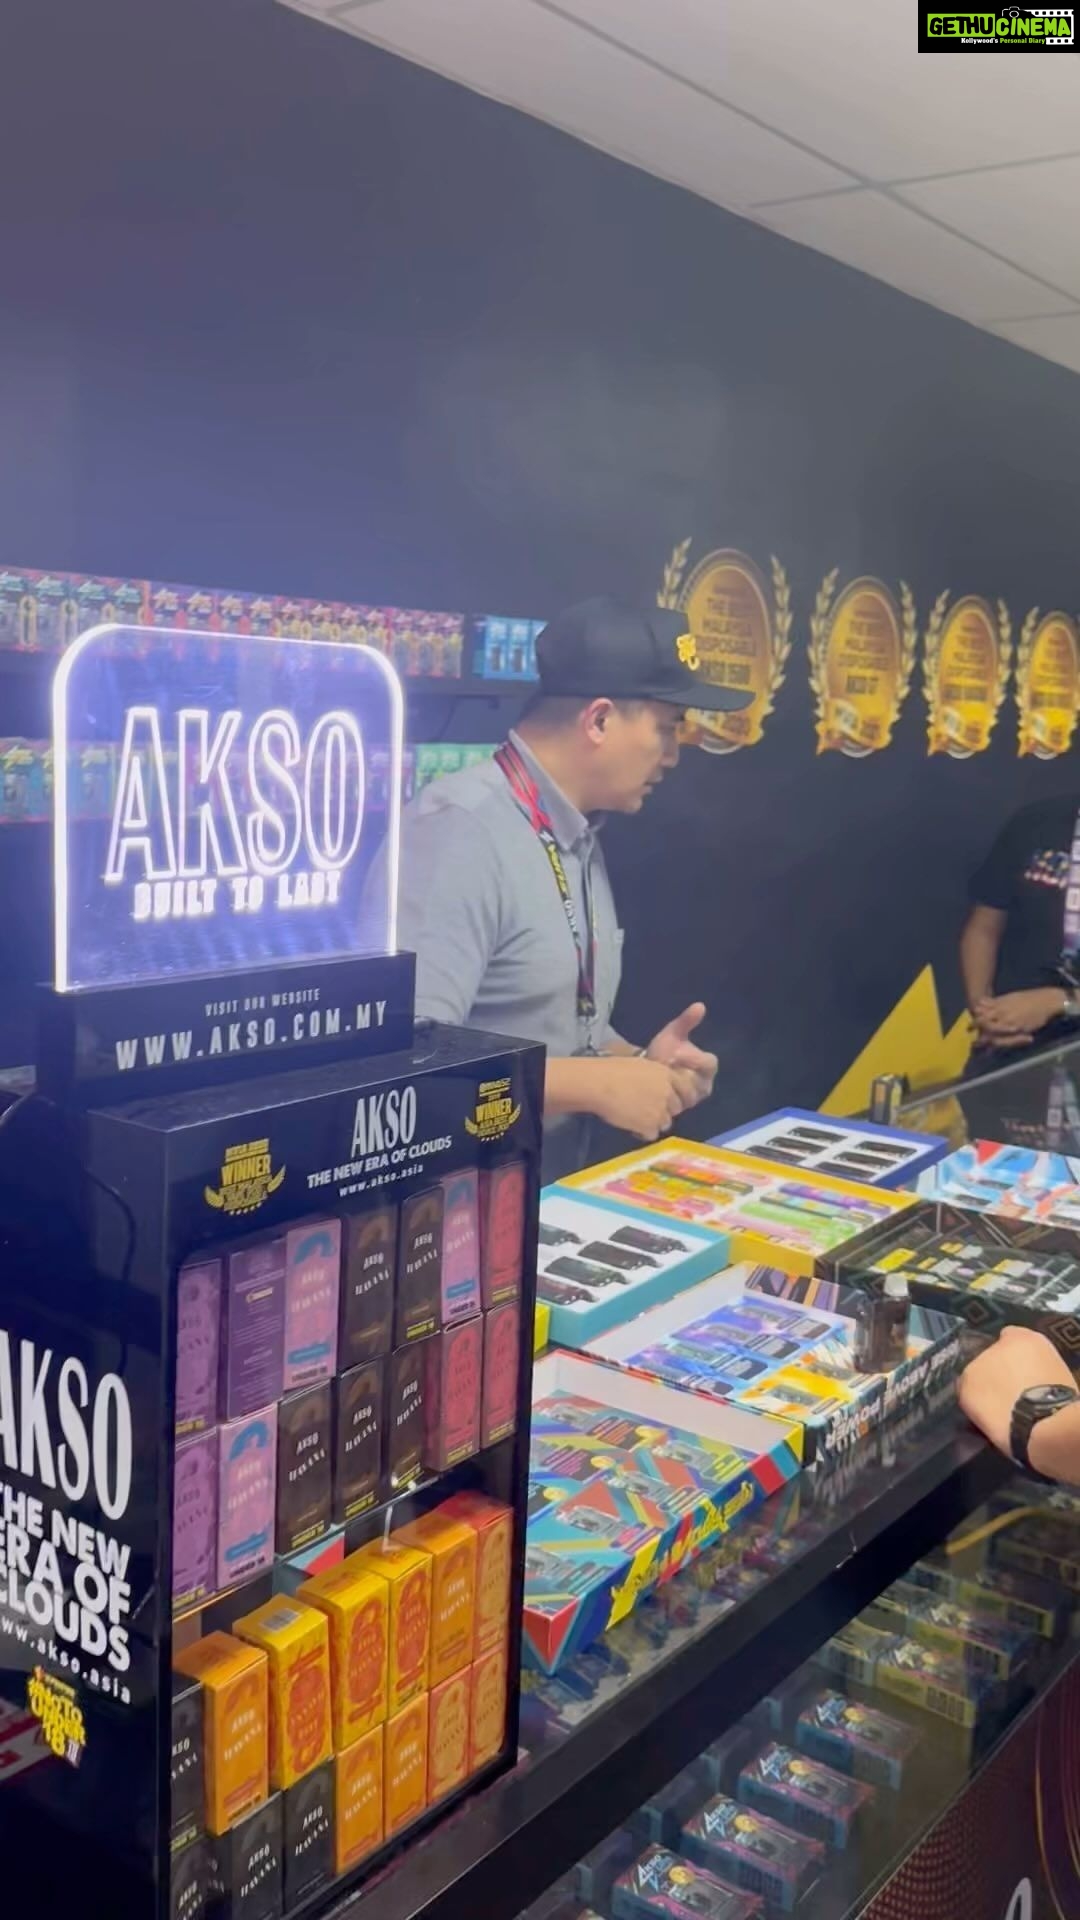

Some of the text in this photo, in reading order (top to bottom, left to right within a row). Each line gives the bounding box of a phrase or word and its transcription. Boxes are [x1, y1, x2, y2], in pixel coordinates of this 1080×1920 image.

[105, 706, 365, 882] AKSO
[231, 875, 263, 911] TO
[205, 1000, 237, 1017] VISIT
[271, 988, 320, 1007] WEBSITE
[115, 1000, 387, 1071] WWW.AKSO.COM.MY
[351, 1085, 417, 1158] AKSO
[476, 1097, 512, 1122] WINNER
[221, 1153, 272, 1187] WINNER
[306, 1135, 452, 1189] THE NEW ERA OF CLOUDS
[339, 1163, 423, 1197] www.akso.asia
[0, 1516, 131, 1625] RA OF
[52, 1509, 130, 1580] NEW
